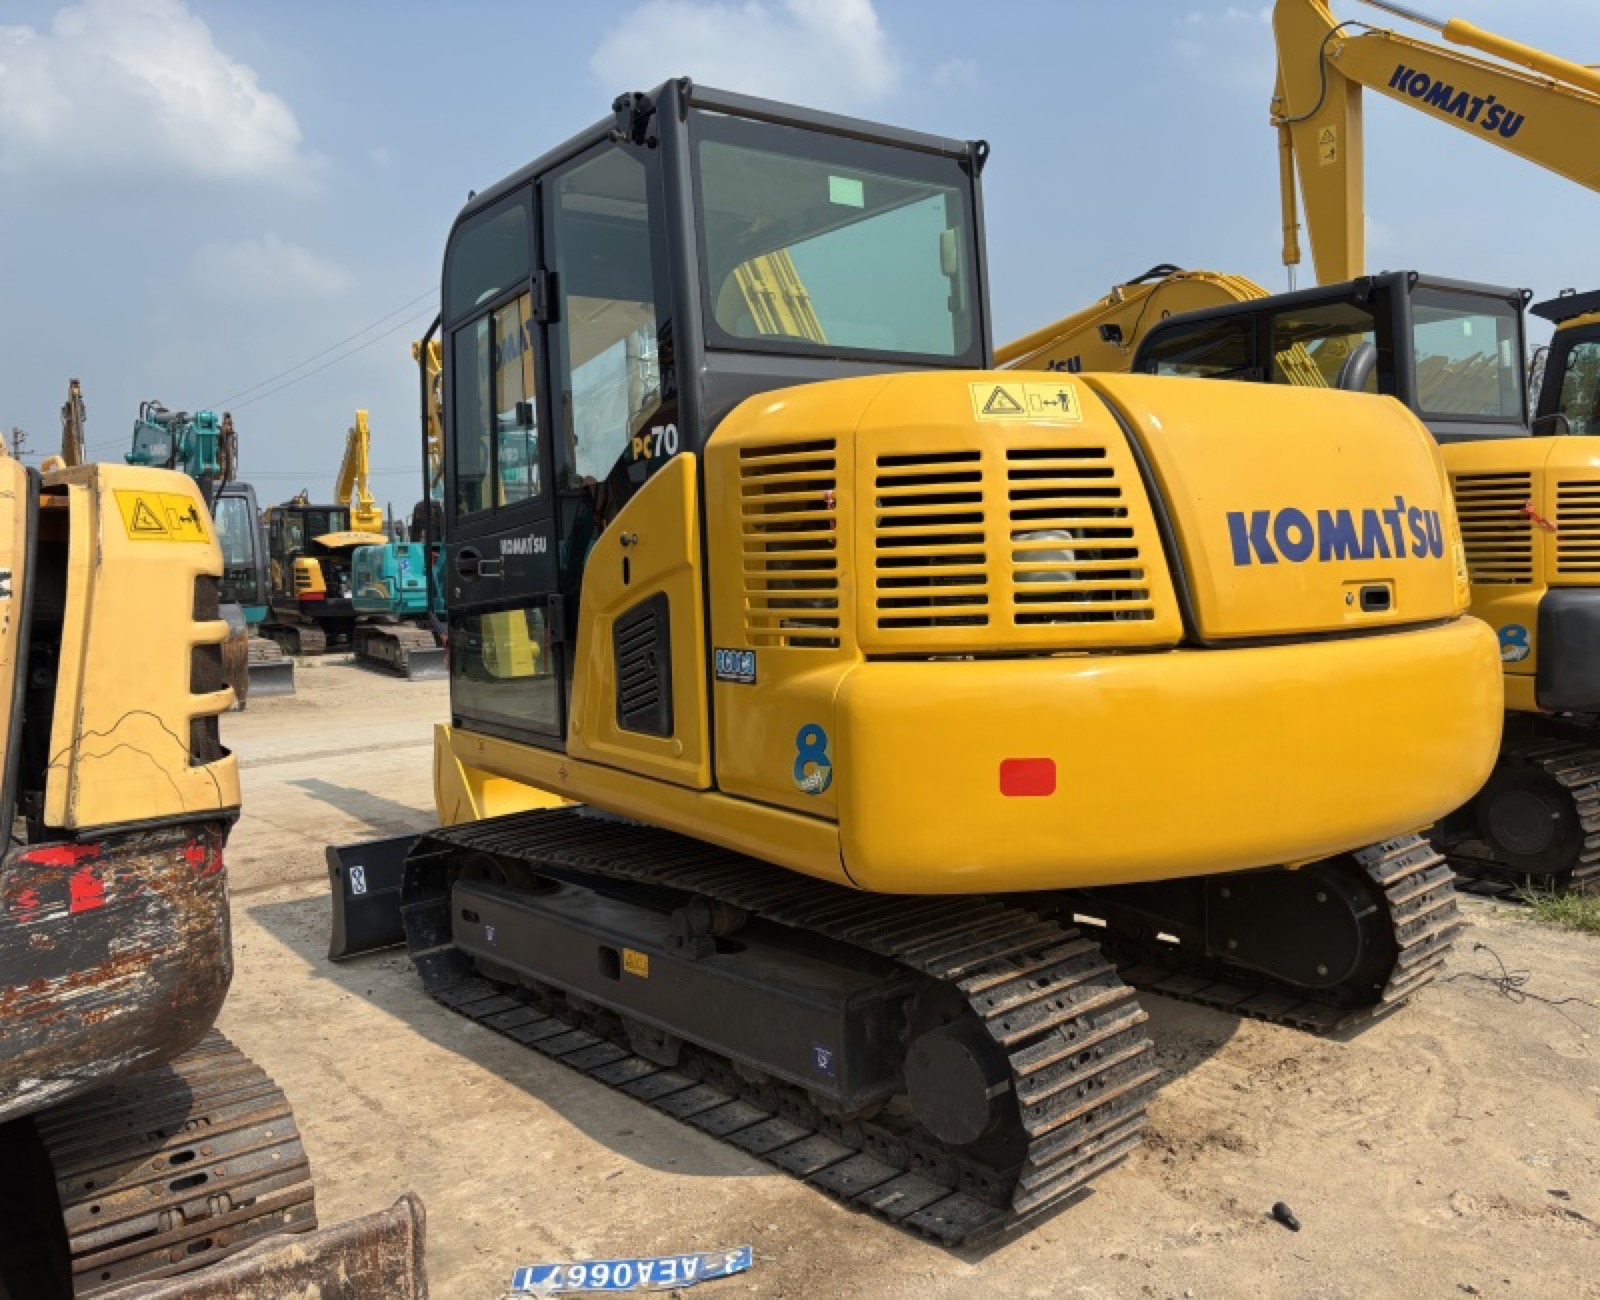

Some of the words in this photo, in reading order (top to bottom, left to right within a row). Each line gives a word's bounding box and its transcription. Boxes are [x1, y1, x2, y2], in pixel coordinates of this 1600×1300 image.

[1388, 64, 1525, 138] KOMATSU
[633, 424, 679, 460] PC70
[500, 534, 547, 554] KOMATSU
[1226, 496, 1444, 566] KOMATSU
